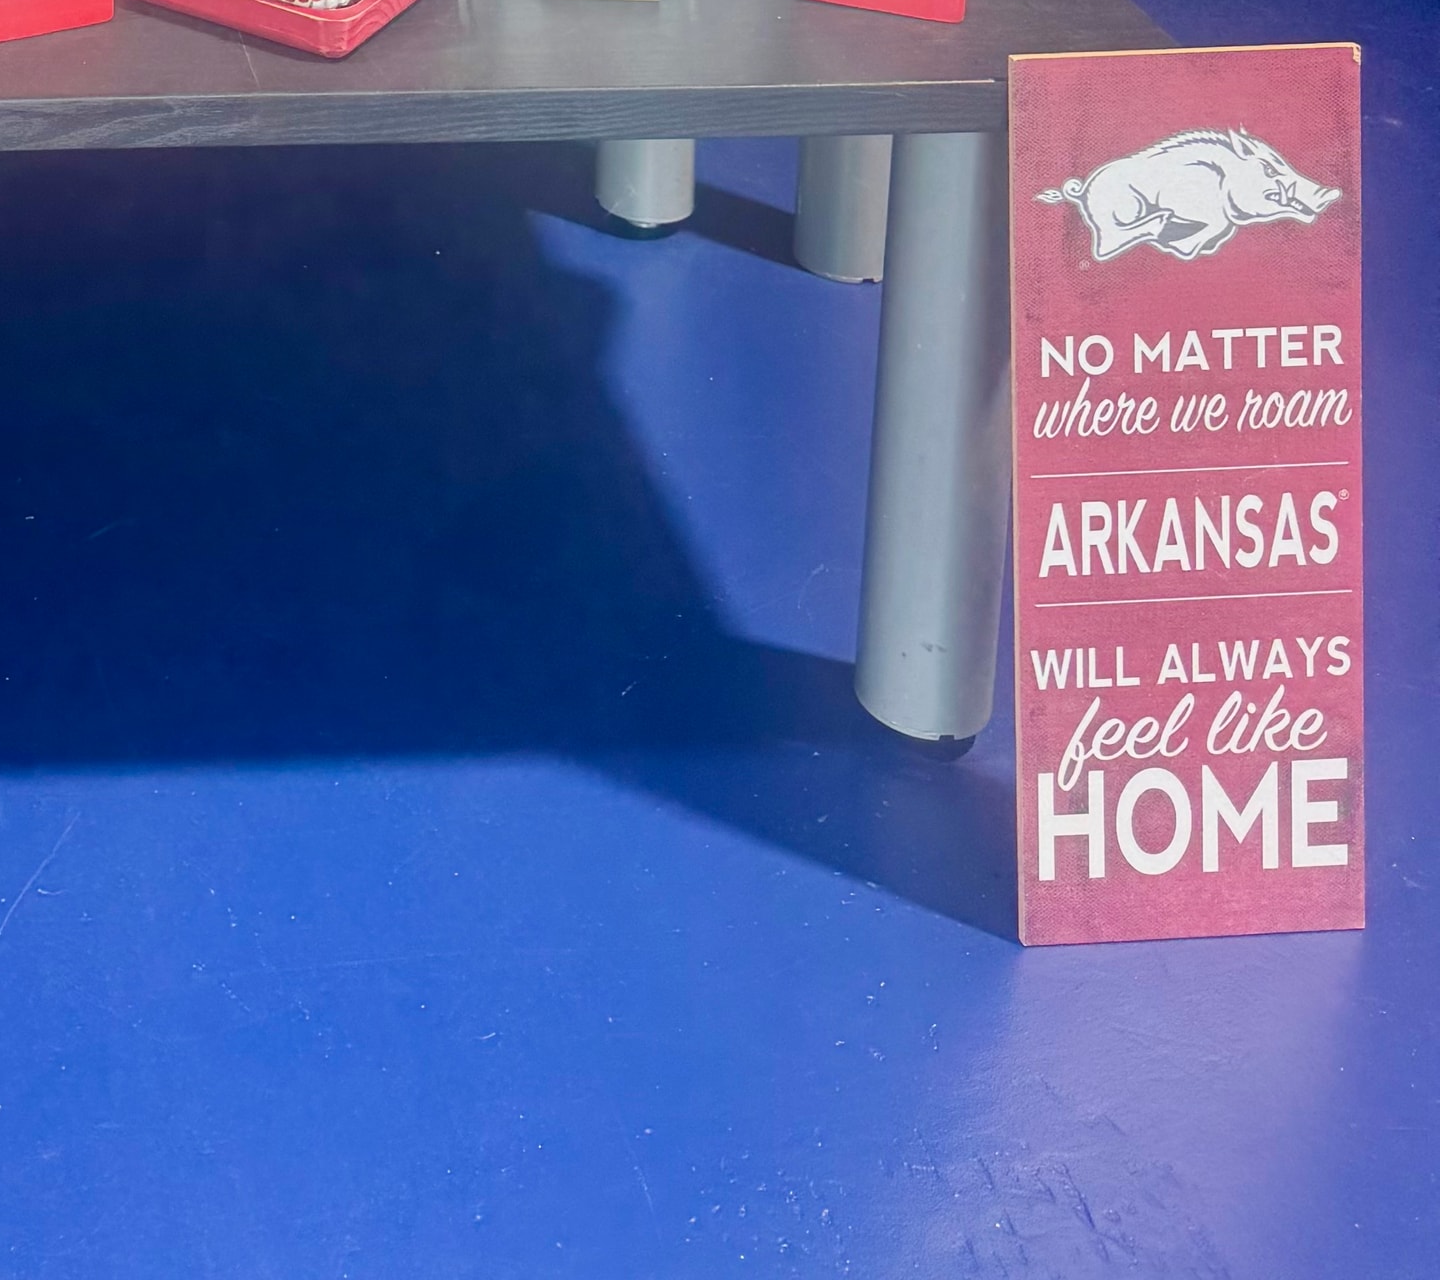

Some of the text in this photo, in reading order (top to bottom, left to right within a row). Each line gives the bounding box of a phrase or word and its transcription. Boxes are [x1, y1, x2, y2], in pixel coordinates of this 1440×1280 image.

[1040, 324, 1344, 379] NO MATTER
[1033, 378, 1353, 441] where we roam
[1038, 490, 1341, 579] ARKANSAS
[1030, 636, 1352, 691] WILL ALWAYS
[1058, 683, 1328, 786] feel like
[1036, 757, 1350, 882] HOME
